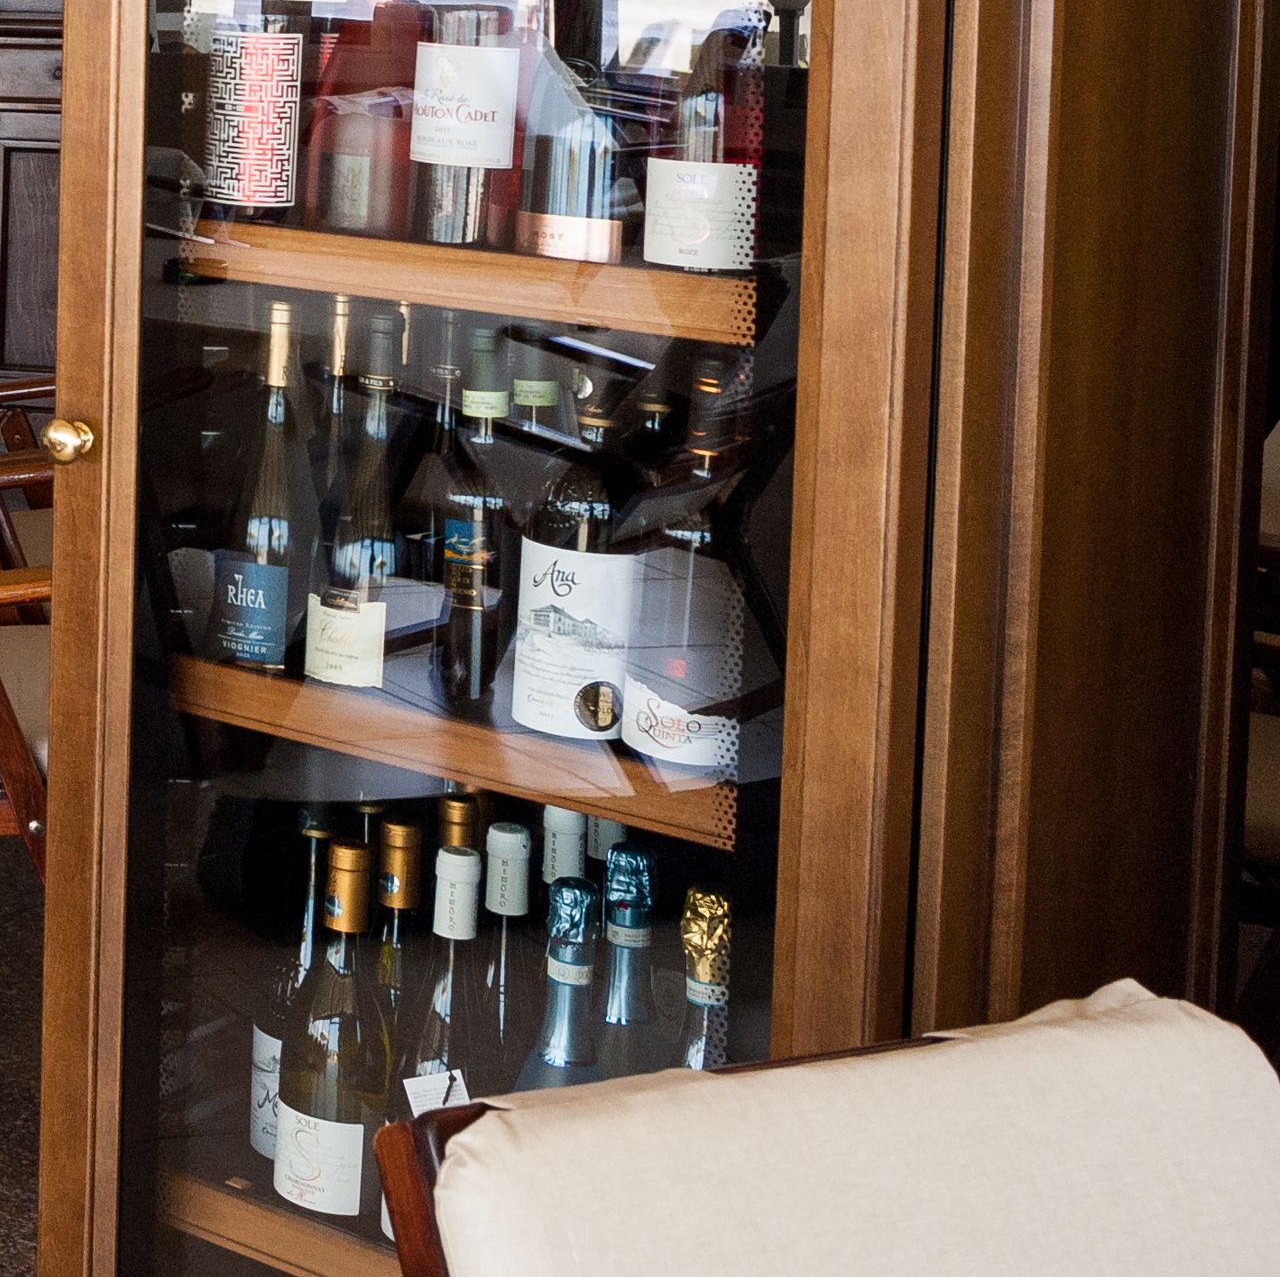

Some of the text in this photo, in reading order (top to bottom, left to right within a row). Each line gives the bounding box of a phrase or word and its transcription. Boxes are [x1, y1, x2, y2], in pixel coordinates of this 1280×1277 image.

[456, 103, 498, 124] CADET
[227, 573, 268, 610] RHEA
[532, 558, 582, 598] Ana
[222, 640, 268, 654] VIOGNIER
